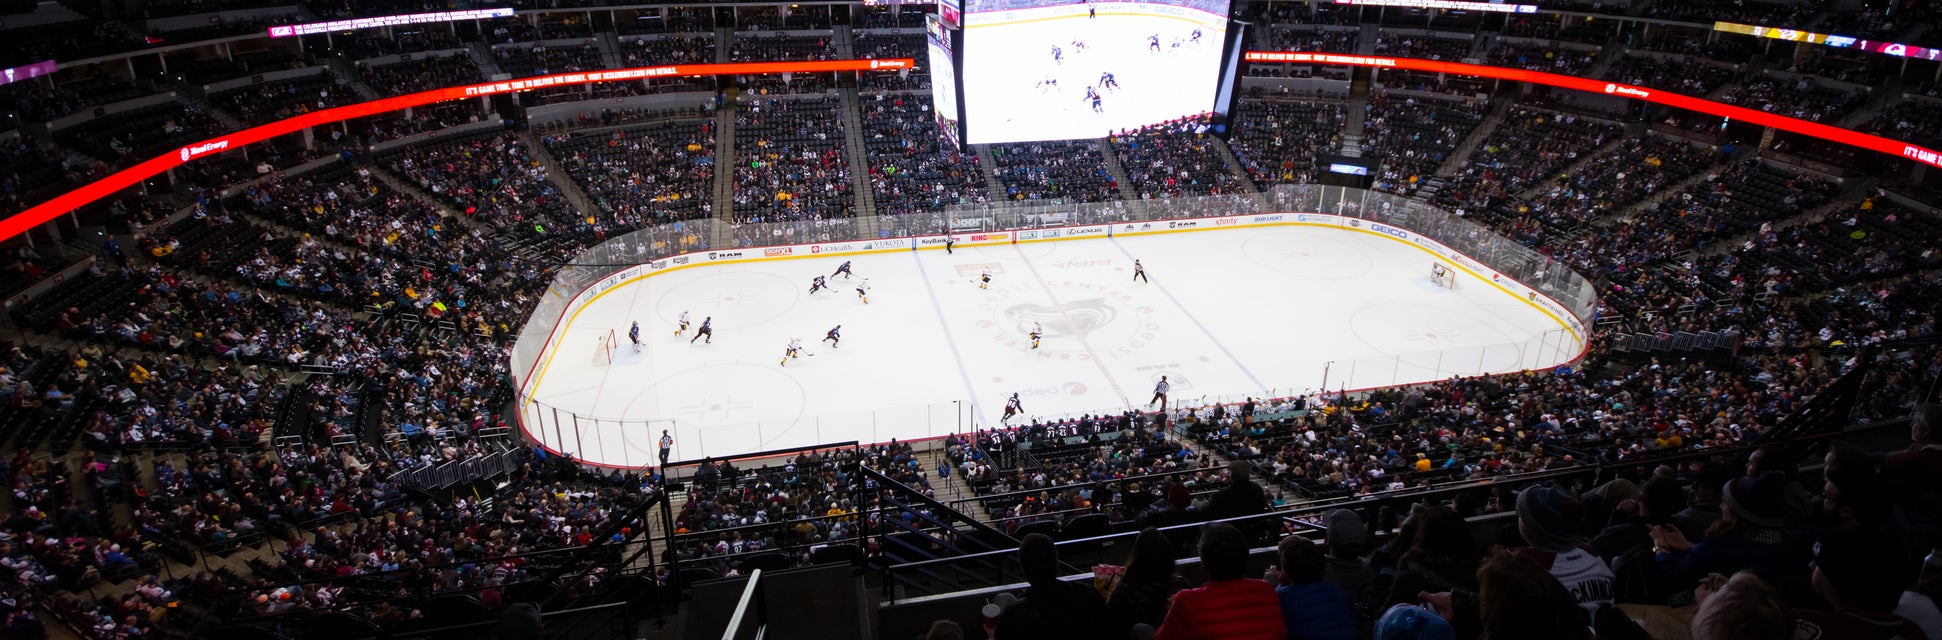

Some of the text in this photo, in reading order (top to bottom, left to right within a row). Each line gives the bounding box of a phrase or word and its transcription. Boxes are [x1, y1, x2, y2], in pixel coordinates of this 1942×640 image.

[206, 140, 228, 150] Energy
[1904, 146, 1918, 158] IT'S
[1918, 150, 1937, 164] GAME
[1215, 217, 1238, 226] xfinity
[1371, 224, 1407, 239] GEICO
[1535, 297, 1564, 318] DRAFTKINGS
